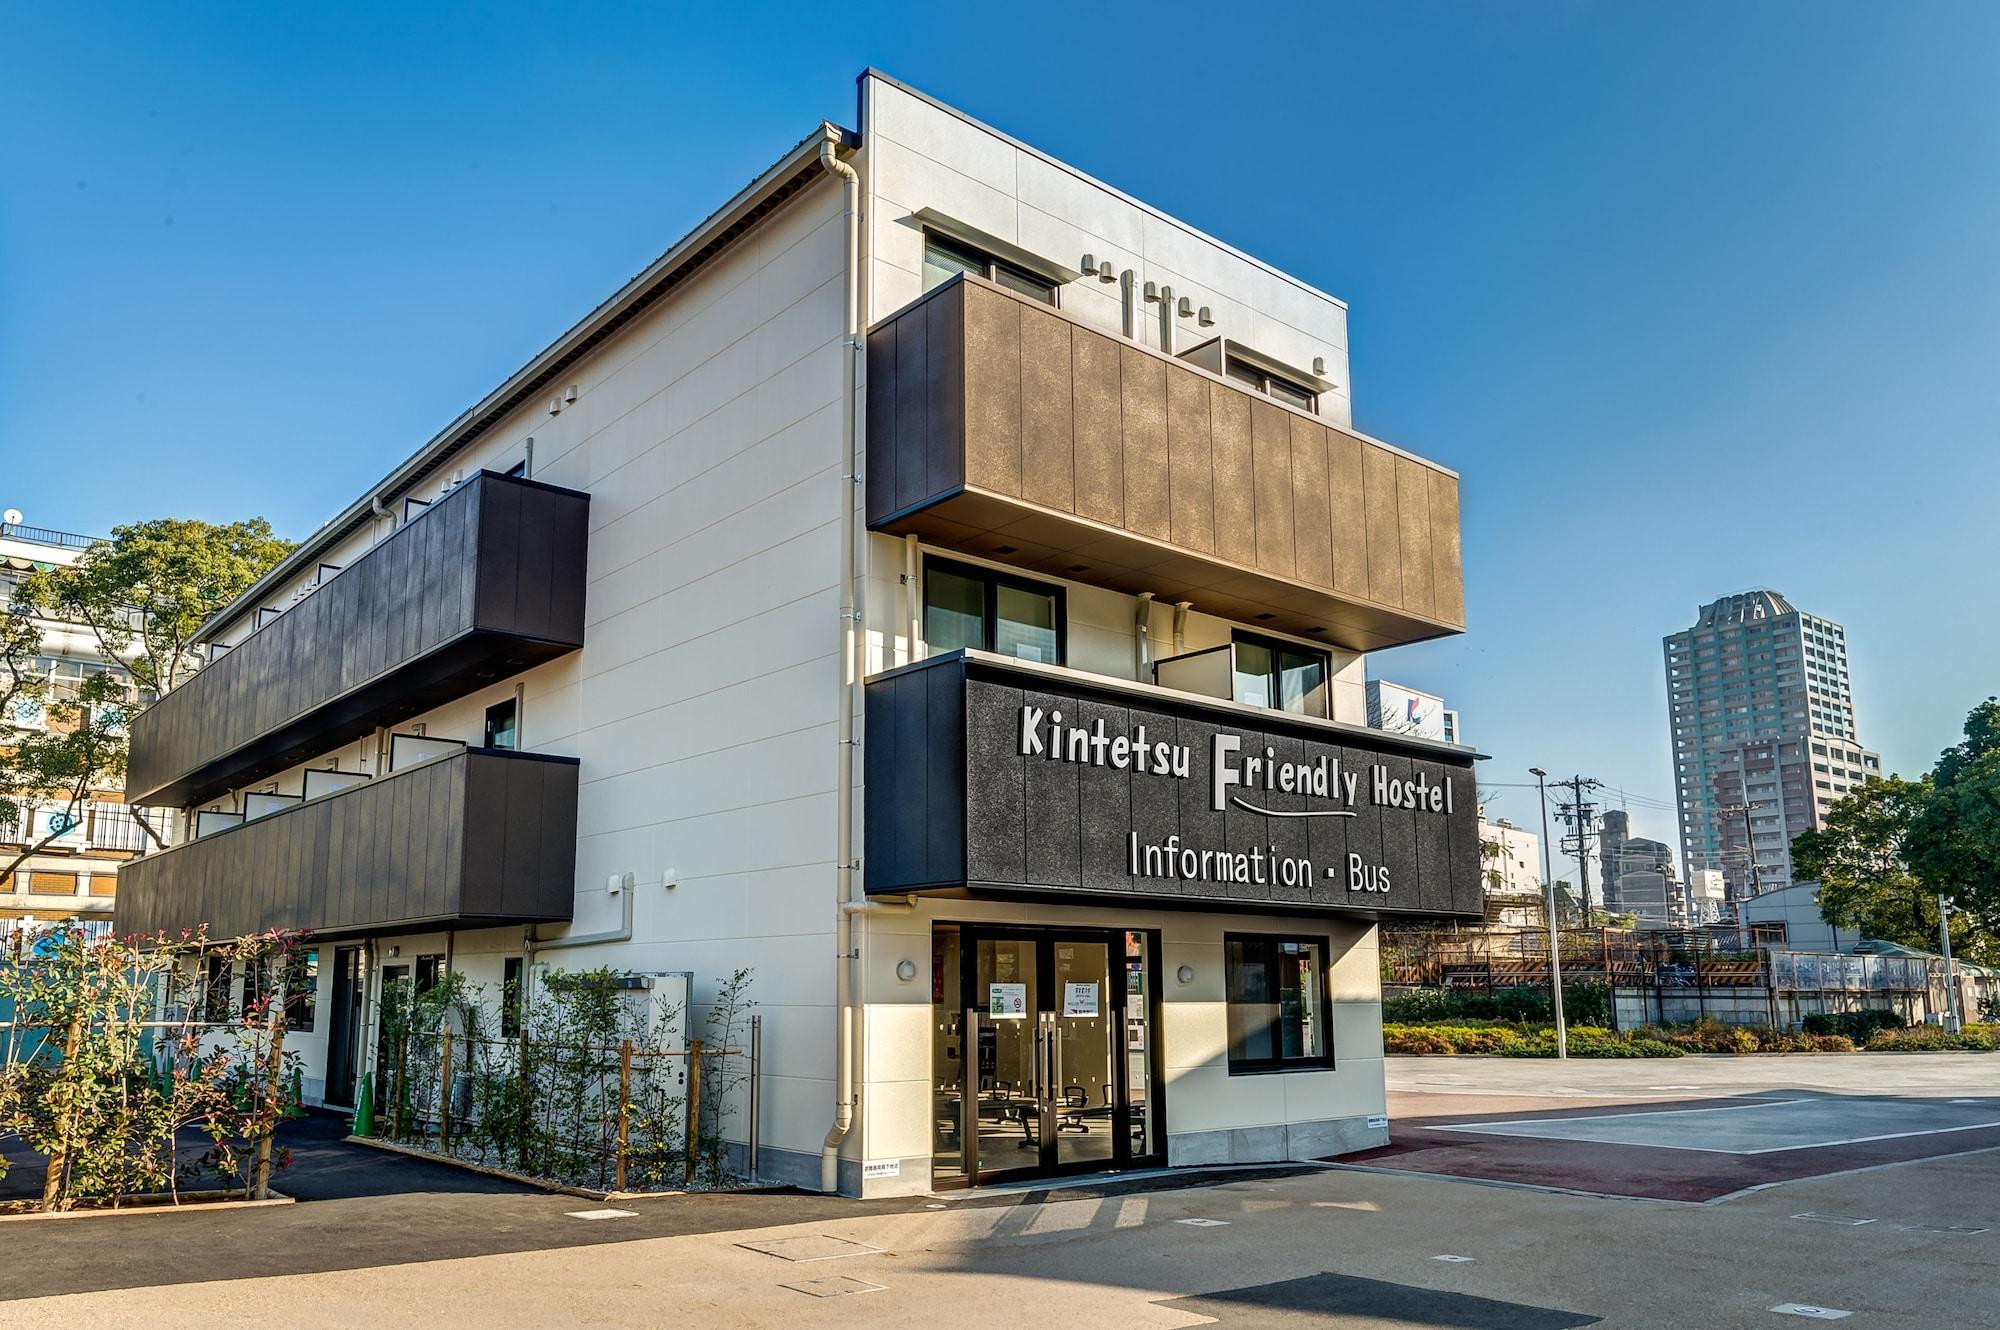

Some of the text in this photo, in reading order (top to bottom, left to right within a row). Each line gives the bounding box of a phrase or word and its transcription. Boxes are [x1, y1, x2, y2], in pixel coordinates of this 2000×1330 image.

[1021, 705, 1453, 814] Kintetsu Friendly Hostel
[1131, 831, 1313, 888] Information
[1349, 853, 1391, 893] Bus
